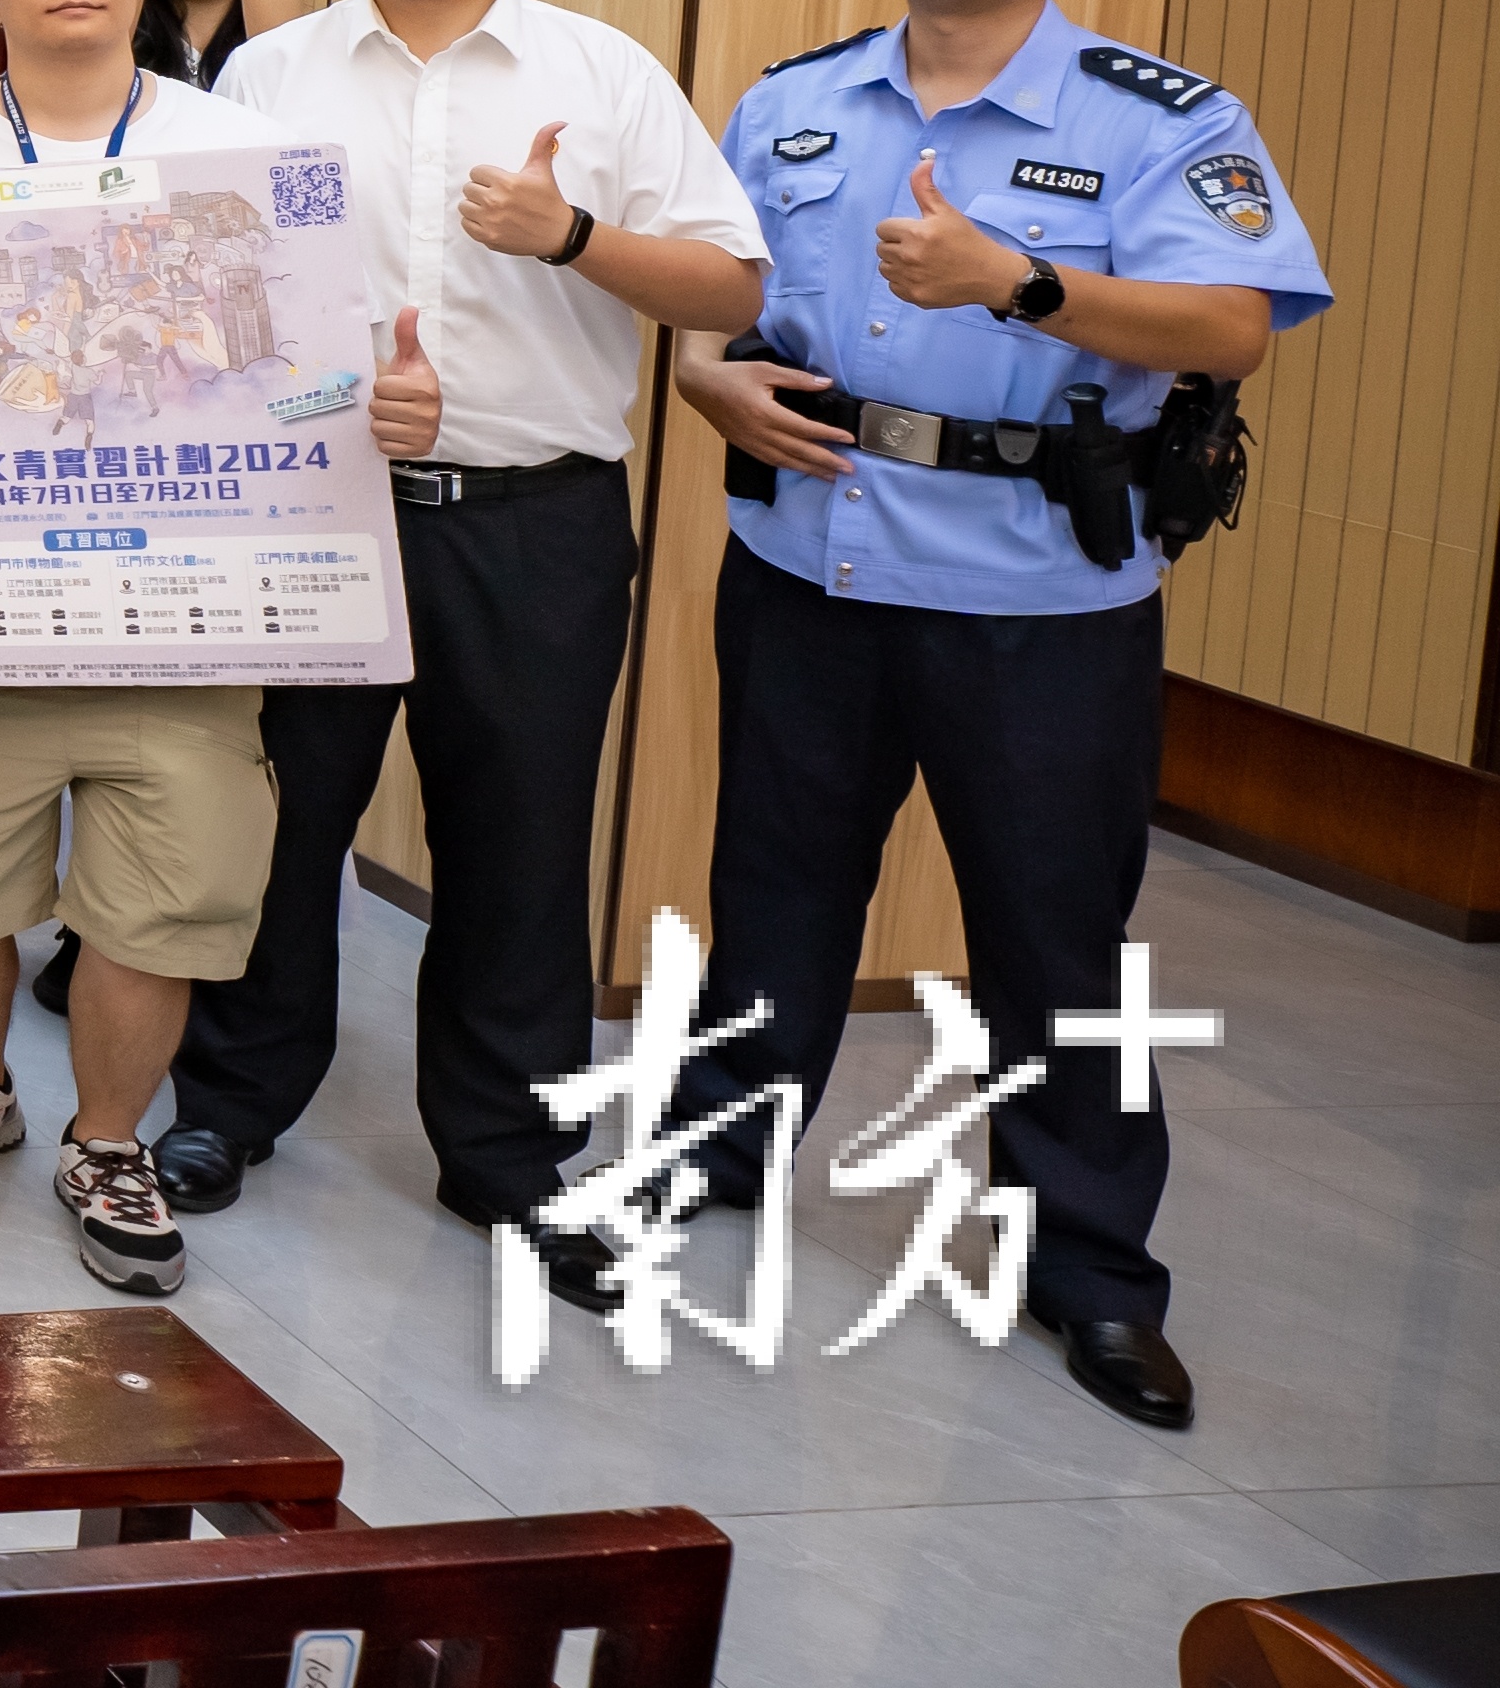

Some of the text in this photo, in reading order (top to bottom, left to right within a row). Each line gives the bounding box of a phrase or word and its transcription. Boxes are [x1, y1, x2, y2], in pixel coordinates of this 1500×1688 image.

[1017, 165, 1100, 193] 441309
[55, 531, 133, 549] 實習崗位
